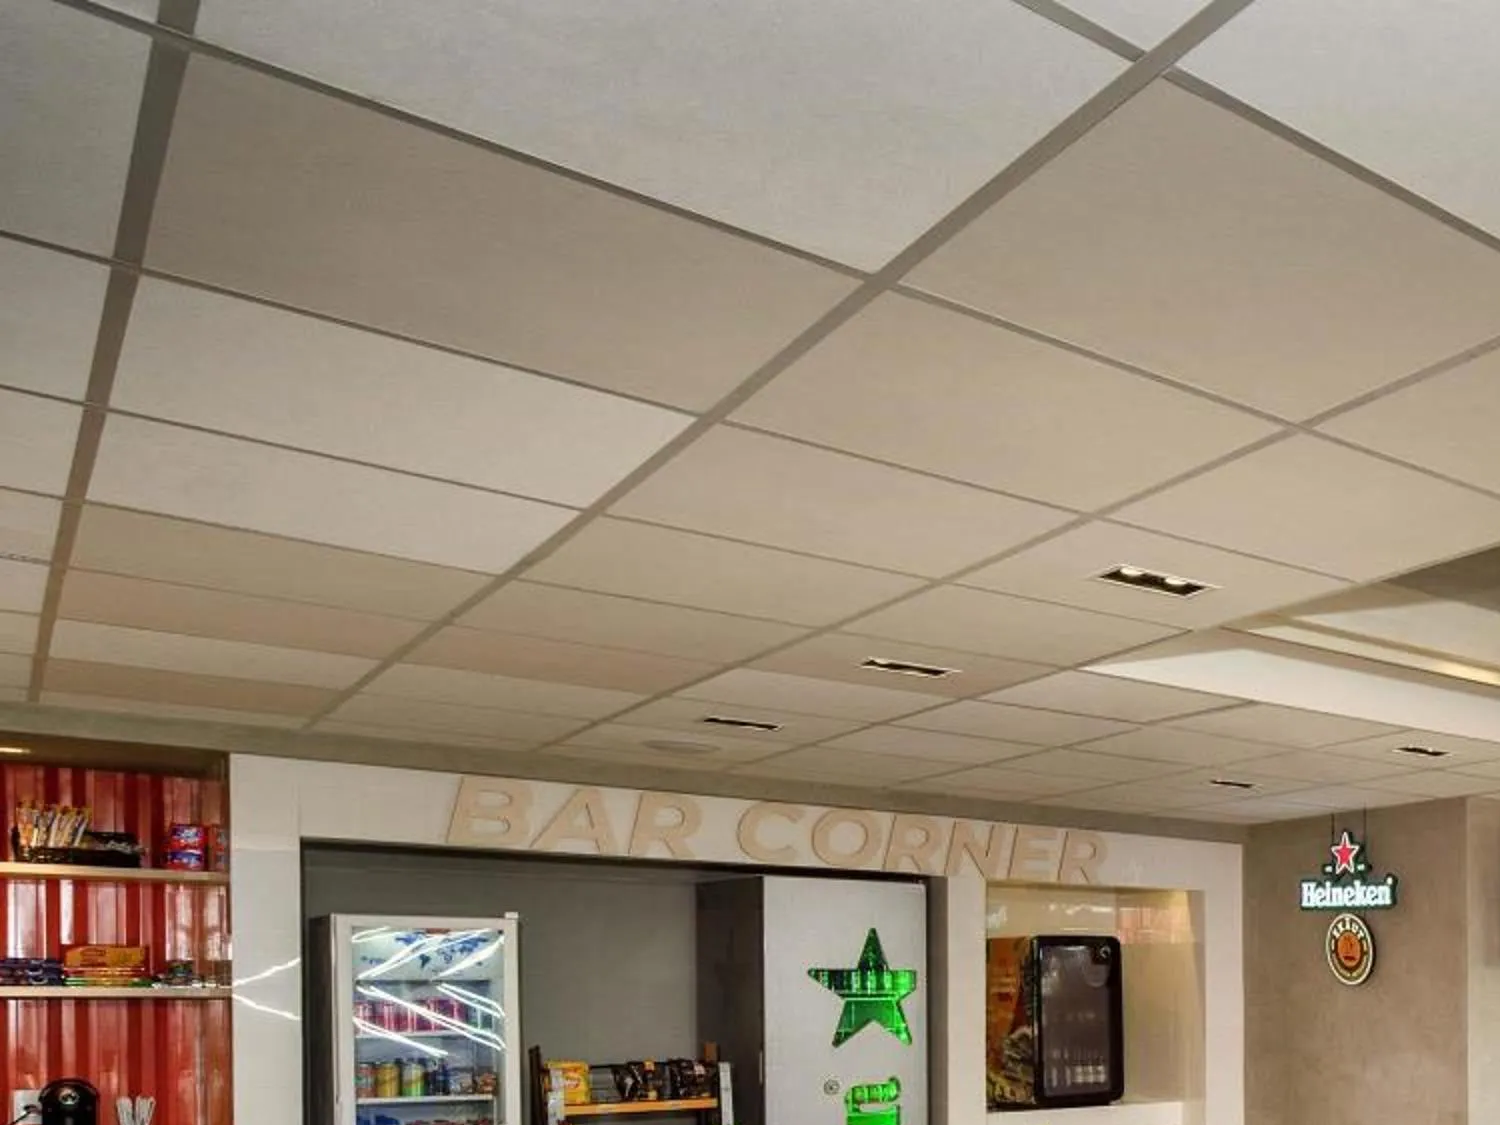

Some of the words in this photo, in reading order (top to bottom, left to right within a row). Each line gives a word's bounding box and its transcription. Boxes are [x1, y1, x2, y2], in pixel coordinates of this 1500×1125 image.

[445, 775, 703, 859] BAR
[736, 802, 1108, 884] CORNER
[1301, 879, 1393, 907] Heineken
